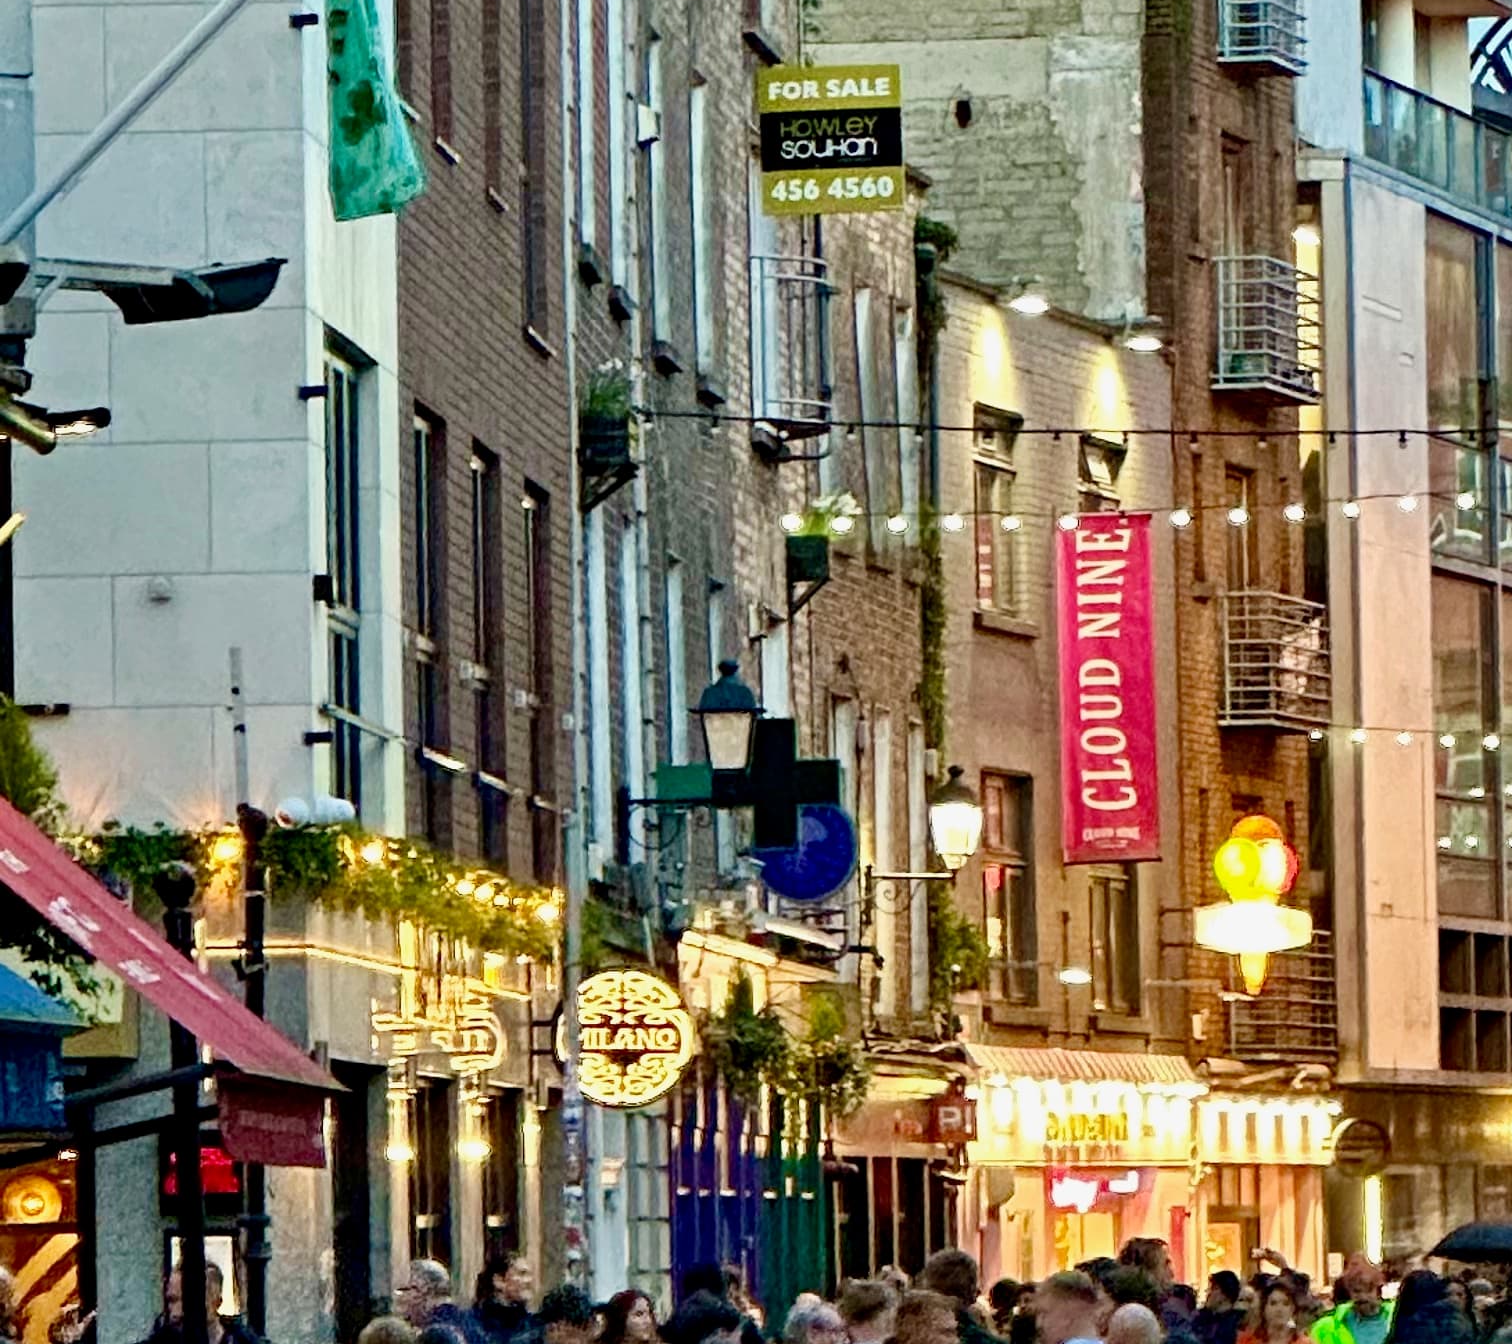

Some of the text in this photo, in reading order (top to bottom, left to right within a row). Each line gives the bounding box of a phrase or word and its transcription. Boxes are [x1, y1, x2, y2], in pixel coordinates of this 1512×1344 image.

[768, 76, 891, 101] FOR SALE
[771, 175, 895, 202] 456 4560
[1078, 657, 1139, 812] CLOUD
